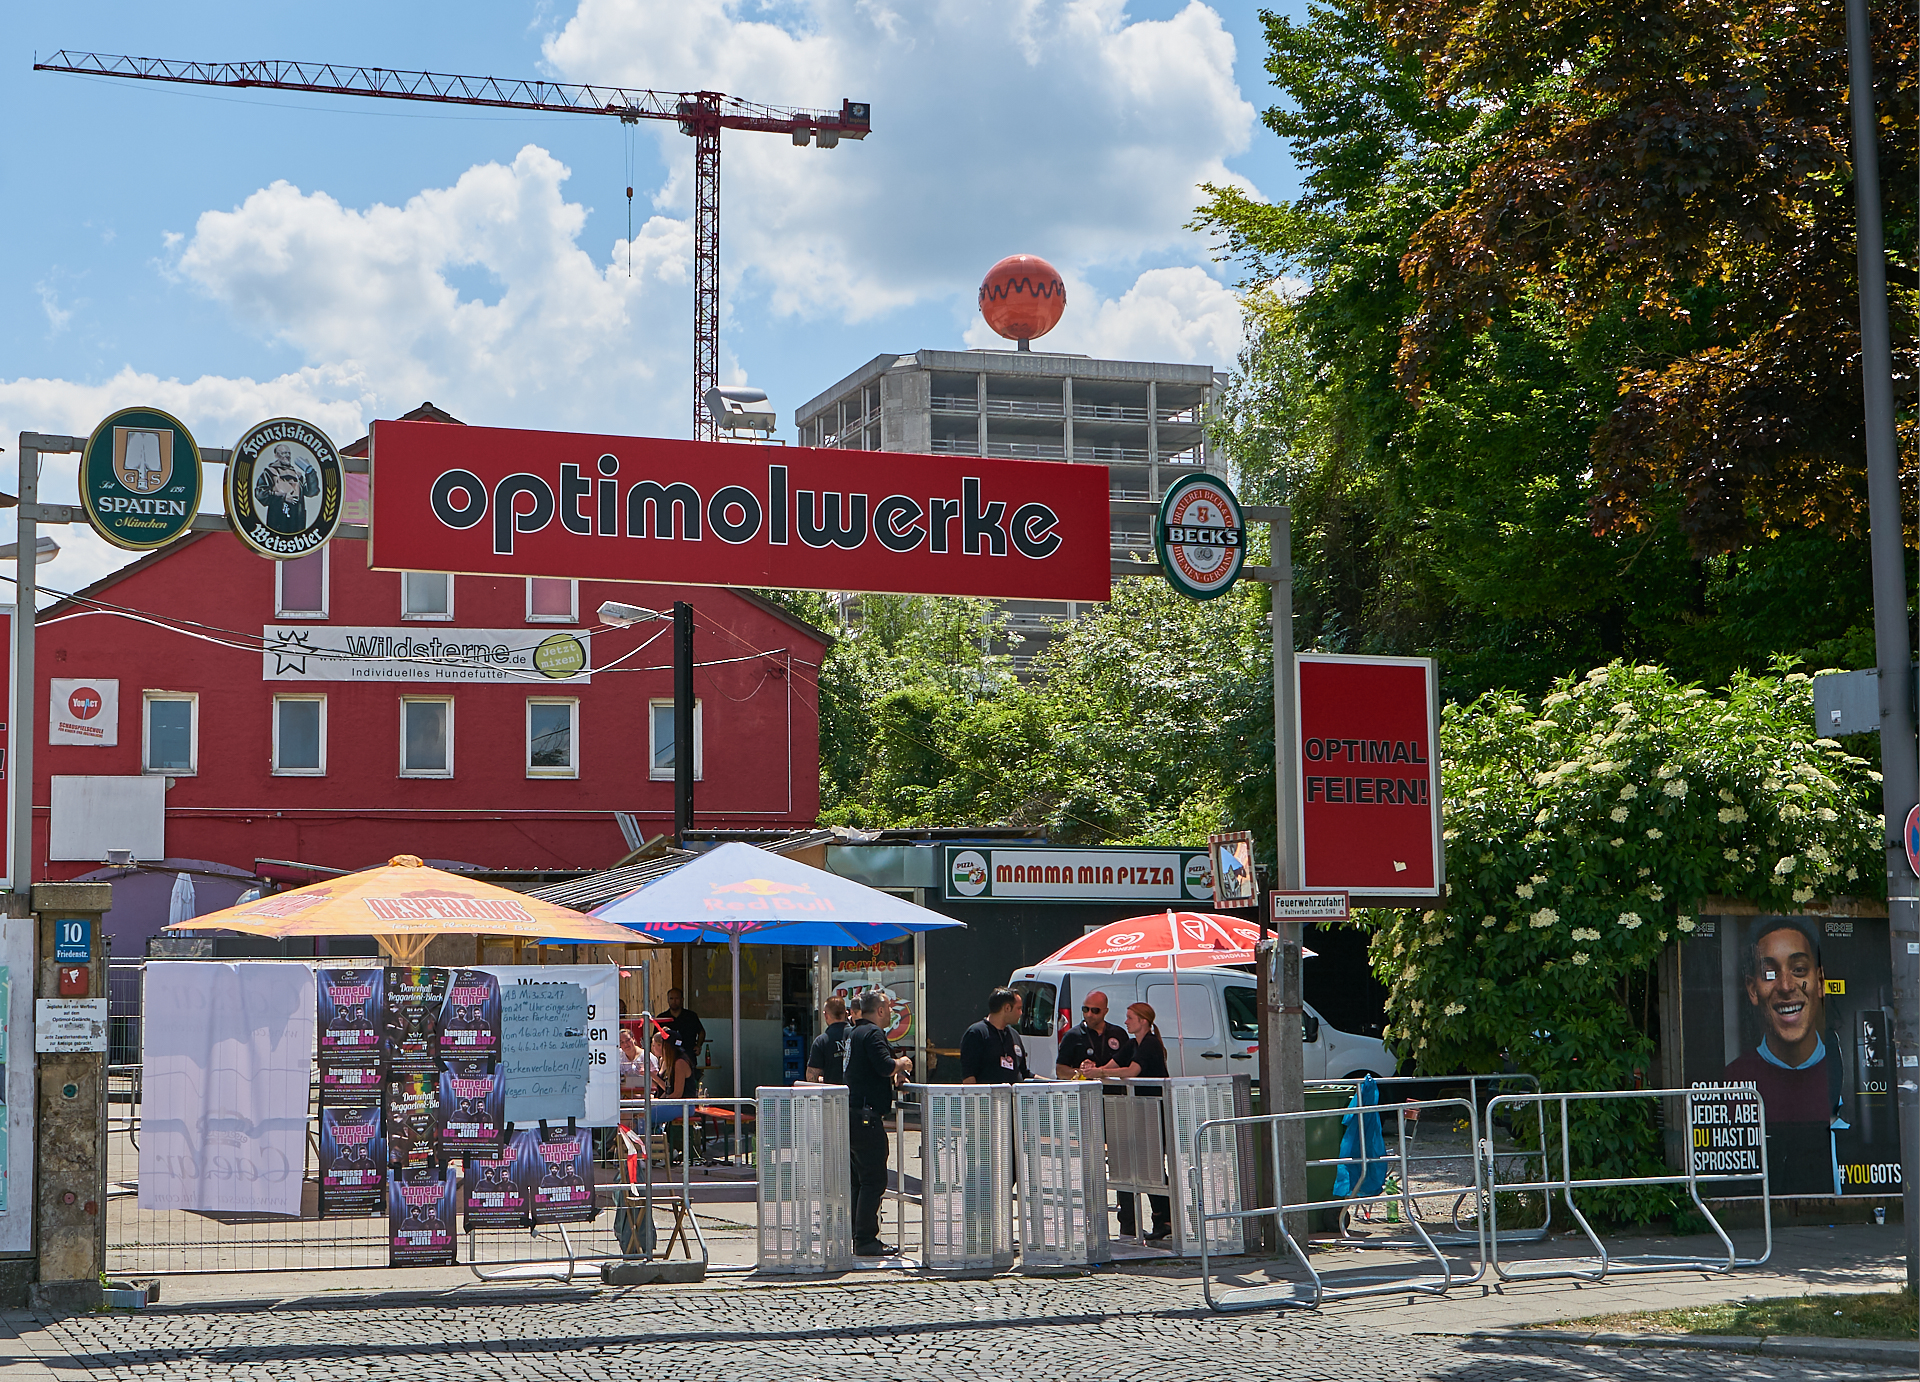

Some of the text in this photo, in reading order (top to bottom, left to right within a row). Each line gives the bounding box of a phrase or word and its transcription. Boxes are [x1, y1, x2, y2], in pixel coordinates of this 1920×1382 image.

[243, 423, 333, 464] Franziskaner
[98, 497, 186, 516] SPATEN
[430, 453, 1063, 561] optimolwerke
[1174, 490, 1202, 524] BRAUEREI
[1204, 490, 1225, 506] BECK
[114, 518, 168, 529] München
[250, 524, 324, 554] Weissbier
[1168, 527, 1238, 545] BECK'S
[542, 643, 576, 658] Jetzt
[540, 654, 582, 669] mixen!
[352, 668, 508, 679] Individuelles Hundefutter
[1304, 737, 1427, 764] OPTIMAL
[1306, 776, 1428, 806] FEIERN!
[956, 862, 974, 870] PIZZA
[1188, 865, 1206, 873] PIZZA
[996, 864, 1174, 886] MAMMA MIA PIZZA
[704, 898, 836, 912] Red Bull
[1276, 896, 1345, 908] Feuerwehrzufahrt
[367, 898, 534, 922] DESPERADOS
[63, 922, 82, 943] 10
[514, 924, 542, 932] Beer
[1825, 922, 1854, 932] AXE
[56, 950, 88, 958] Friedenstr.
[838, 956, 897, 972] service
[329, 984, 372, 996] comedy
[400, 983, 432, 993] Dancehall
[836, 983, 880, 1001] PIZZA
[334, 994, 365, 1007] night
[452, 994, 482, 1006] night
[587, 1028, 608, 1041] en
[452, 1079, 493, 1091] comedy
[1691, 1081, 1721, 1101] SOJA
[1863, 1081, 1888, 1092] YOU
[456, 1088, 486, 1099] night
[1692, 1104, 1760, 1126] JEDER, ABE
[331, 1124, 375, 1136] comedy
[336, 1134, 368, 1146] night
[1694, 1127, 1762, 1147] DU HAST DI
[540, 1142, 580, 1154] comedy
[545, 1152, 574, 1164] night
[1694, 1150, 1760, 1171] SPROSSEN.
[401, 1185, 444, 1197] comedy
[406, 1195, 436, 1206] night
